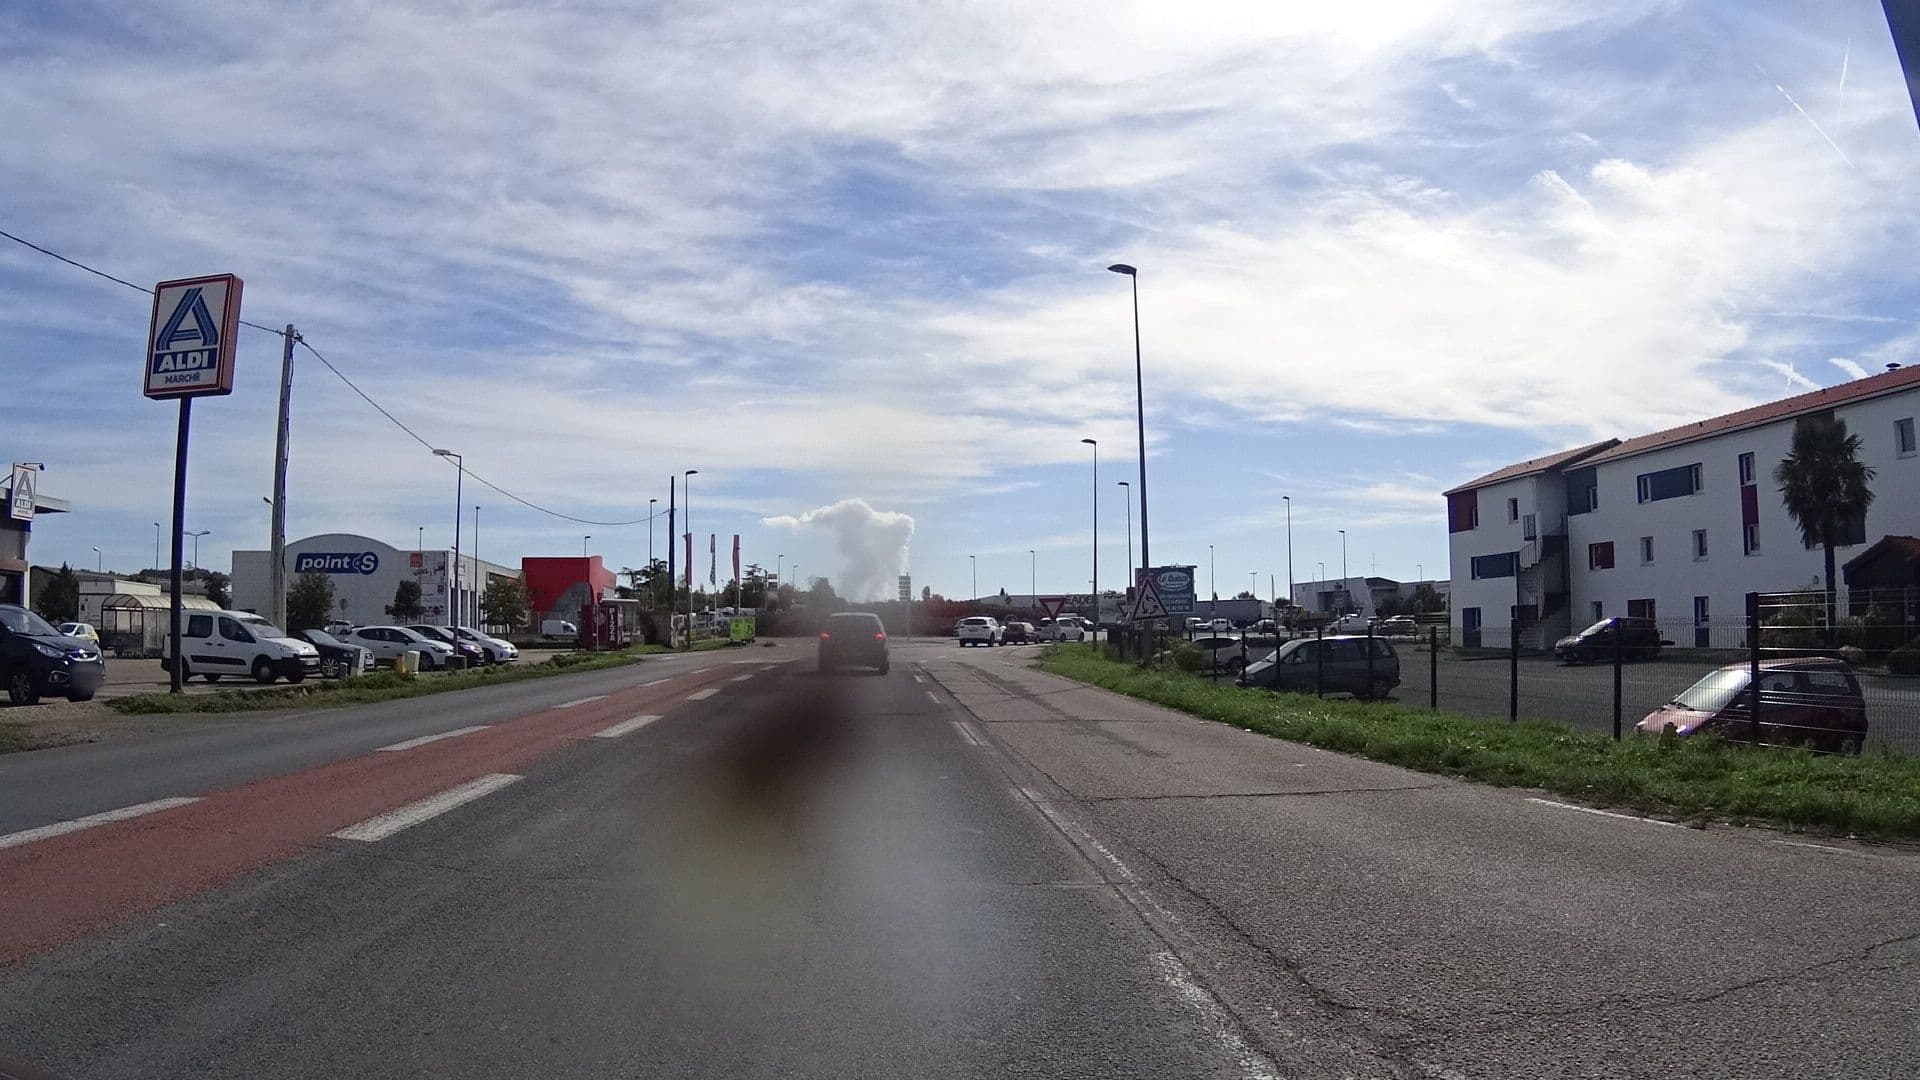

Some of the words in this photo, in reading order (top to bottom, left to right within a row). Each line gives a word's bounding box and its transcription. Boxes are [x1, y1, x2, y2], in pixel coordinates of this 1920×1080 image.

[158, 350, 210, 373] ALDI
[164, 372, 201, 384] MARCHÉ
[301, 555, 351, 571] point
[360, 555, 375, 571] S
